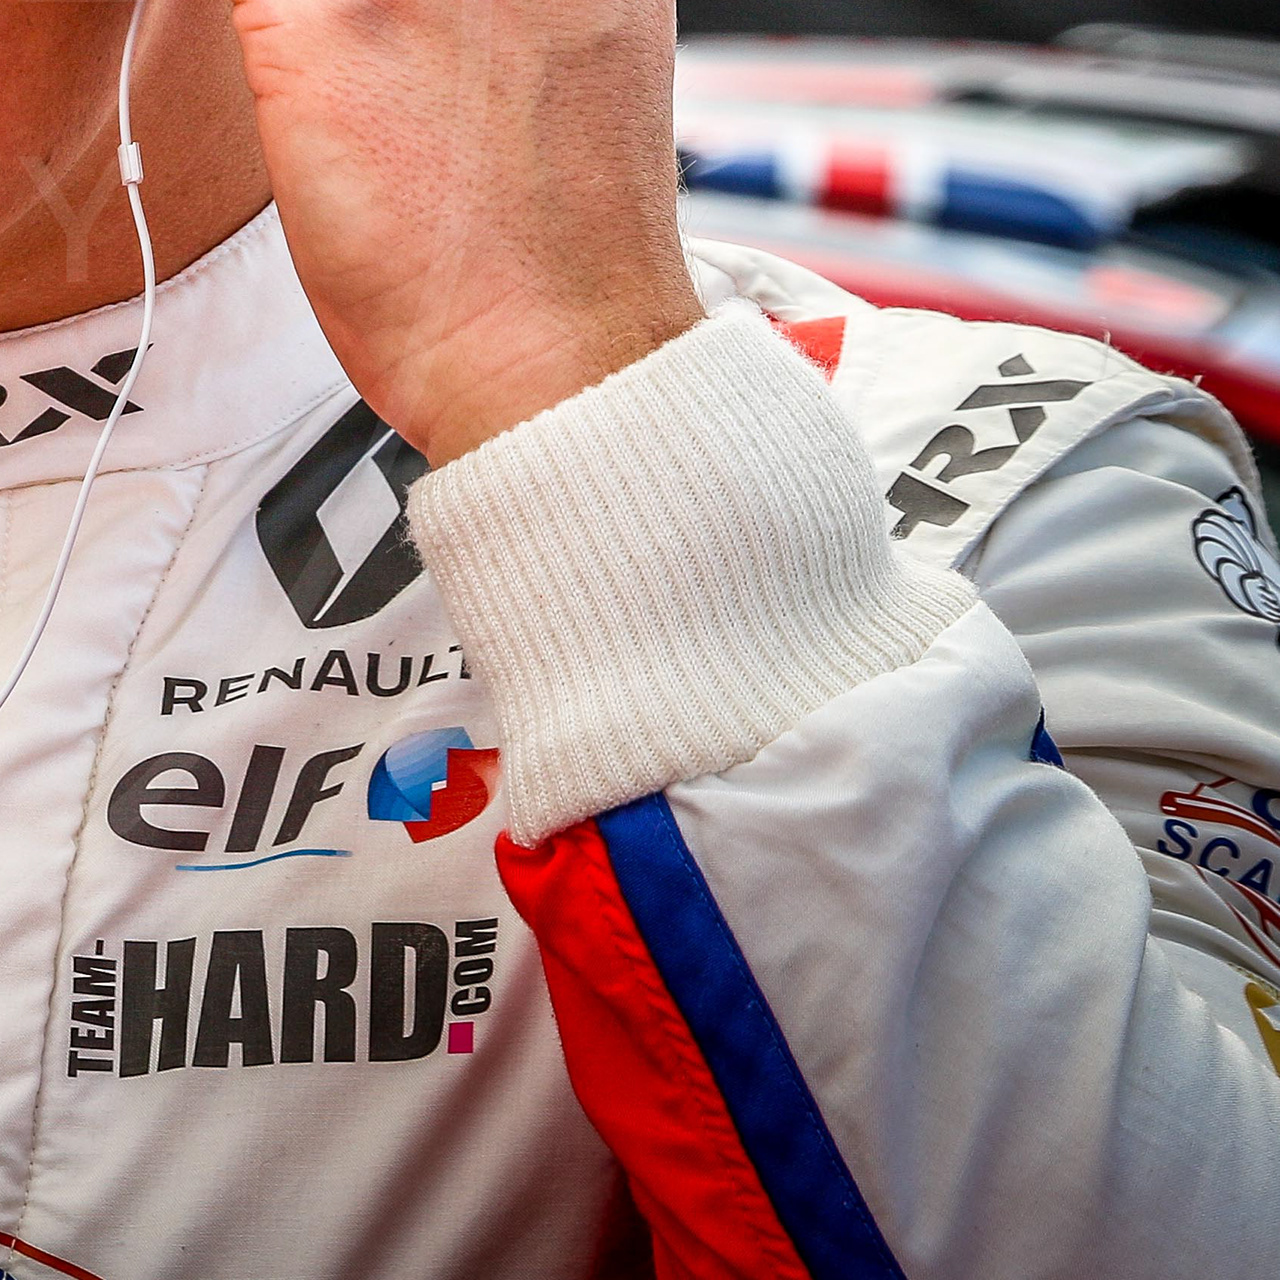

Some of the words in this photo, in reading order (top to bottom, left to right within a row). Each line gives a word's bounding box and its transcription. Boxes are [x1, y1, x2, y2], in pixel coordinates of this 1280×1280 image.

[887, 353, 1092, 538] HRX
[106, 742, 365, 854] elf
[1158, 818, 1280, 906] SCA
[67, 939, 118, 1078] TEAM-
[120, 922, 450, 1078] HARD
